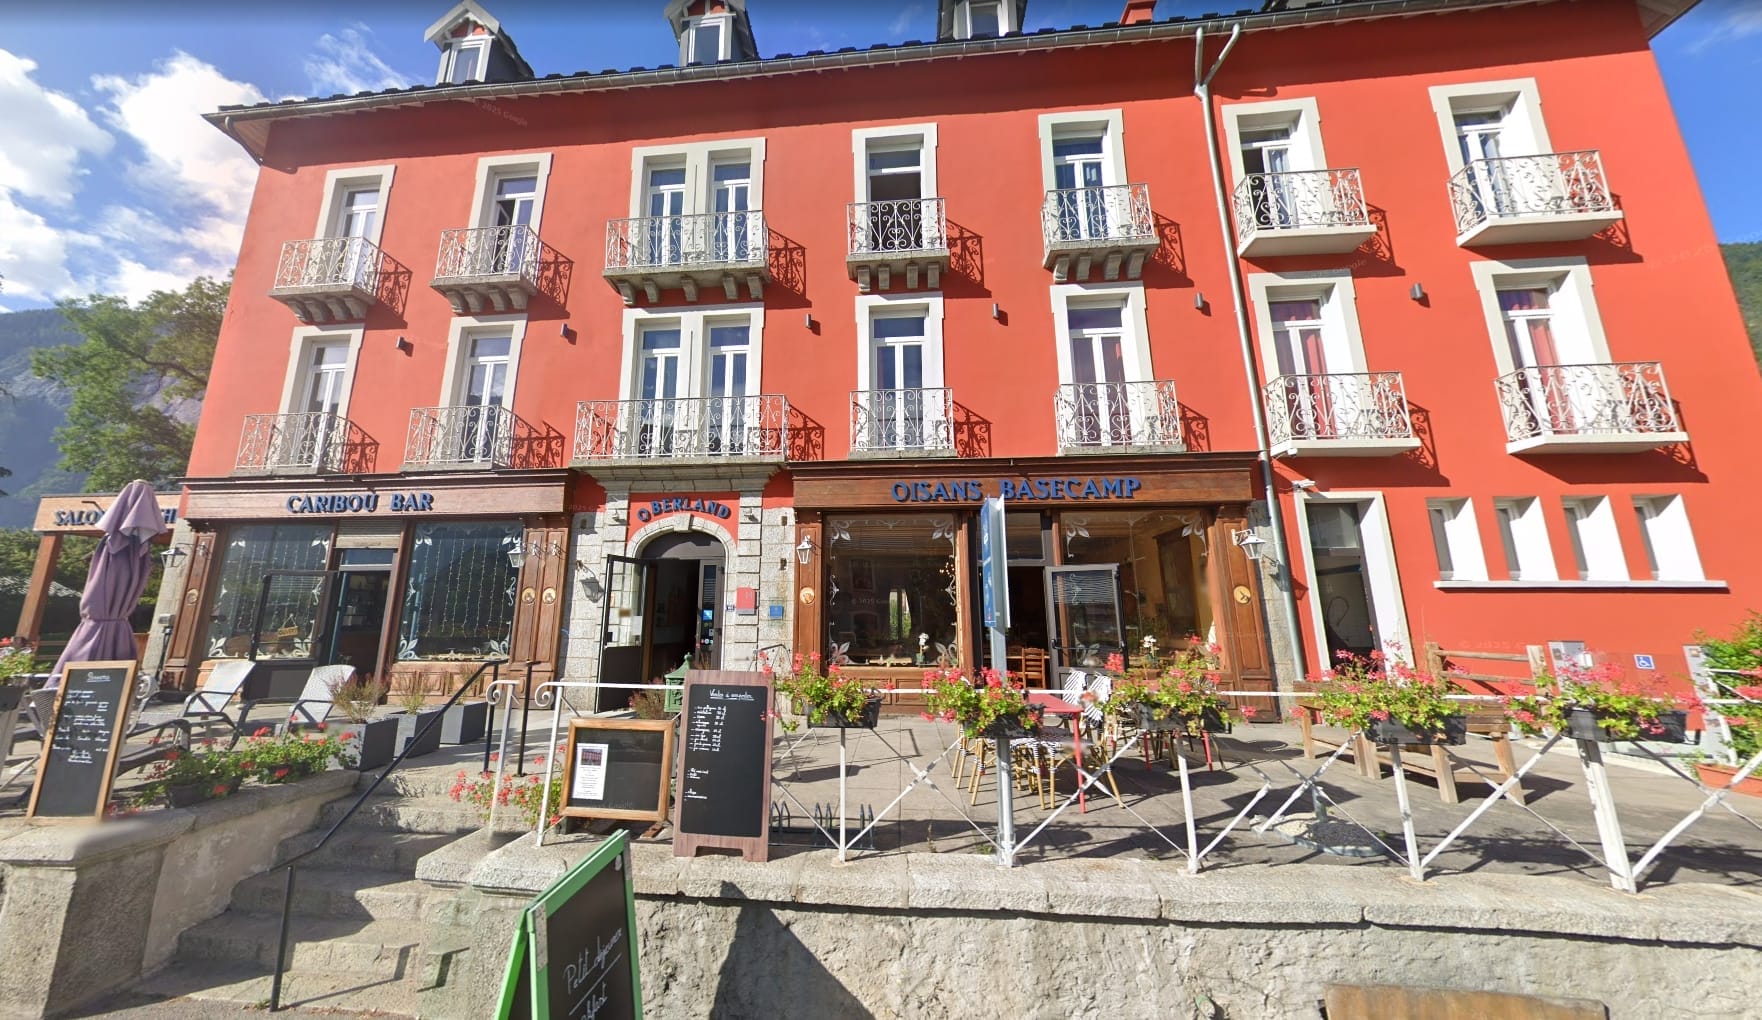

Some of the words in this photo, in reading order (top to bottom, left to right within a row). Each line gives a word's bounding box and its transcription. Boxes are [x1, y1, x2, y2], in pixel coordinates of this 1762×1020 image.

[286, 492, 380, 514] CARIBOU
[390, 491, 435, 513] BAR
[890, 479, 983, 503] OISANS
[999, 476, 1142, 502] BASECAMP
[637, 496, 732, 522] OBERLAND
